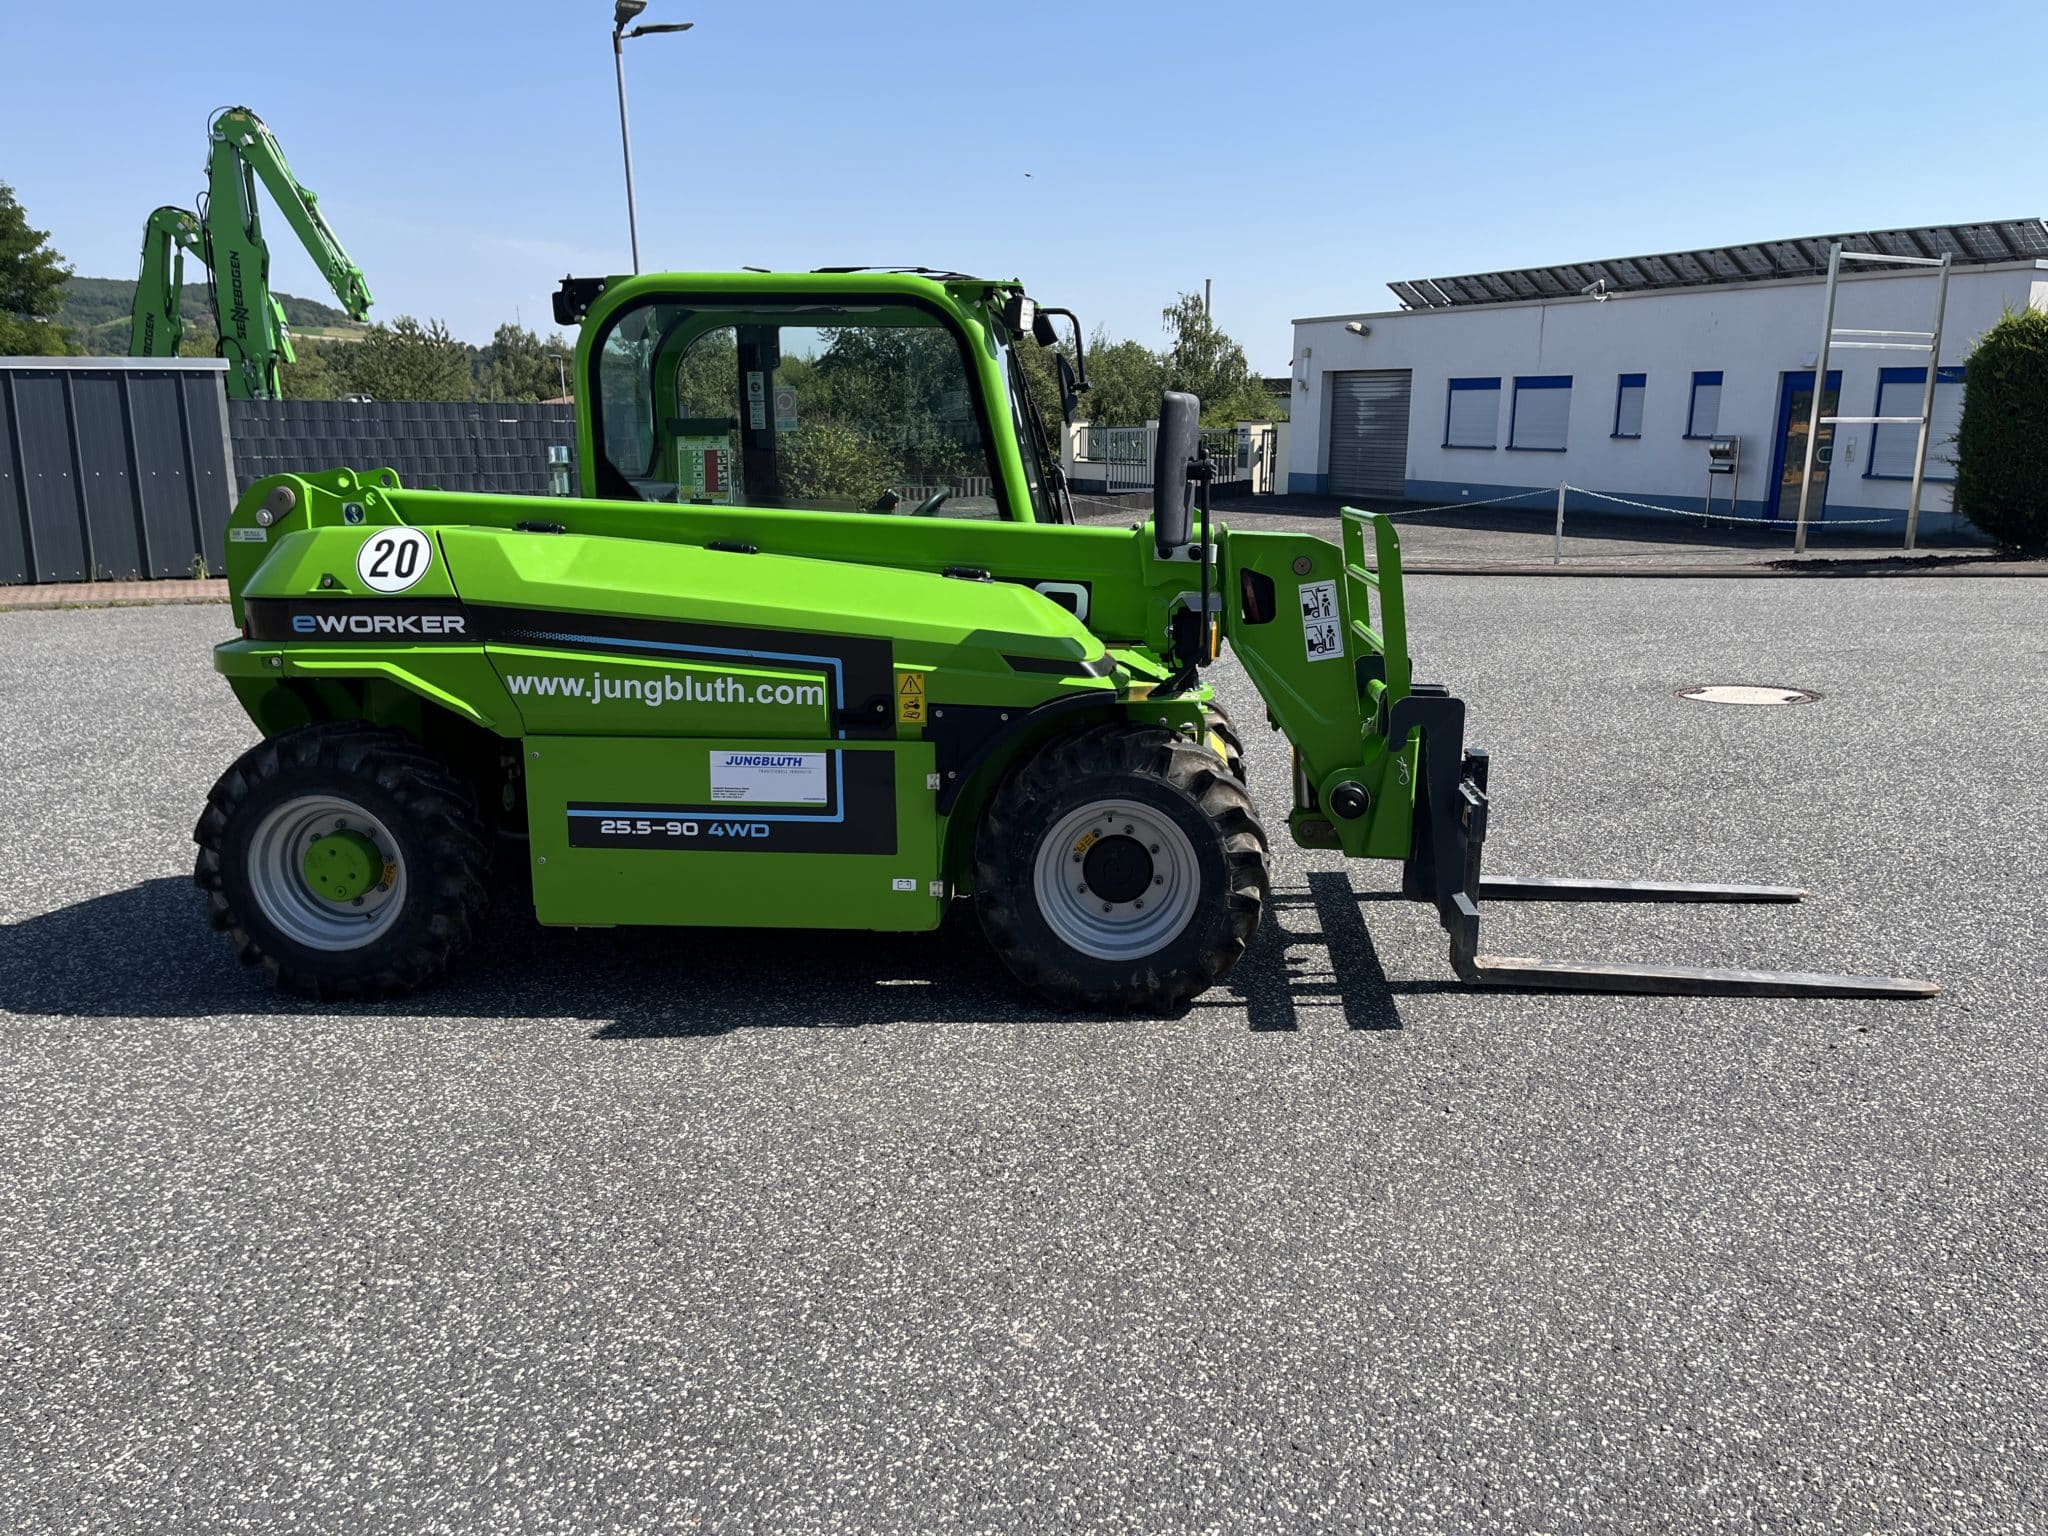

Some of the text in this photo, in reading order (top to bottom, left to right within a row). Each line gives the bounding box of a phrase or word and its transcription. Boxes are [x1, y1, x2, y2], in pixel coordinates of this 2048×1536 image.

[229, 250, 250, 340] SENNEBOGEN
[369, 539, 419, 578] 20
[507, 672, 823, 707] www.jungbluth.com
[726, 755, 802, 767] JUNGBLUTH
[601, 820, 770, 837] 25.5-90 4WD
